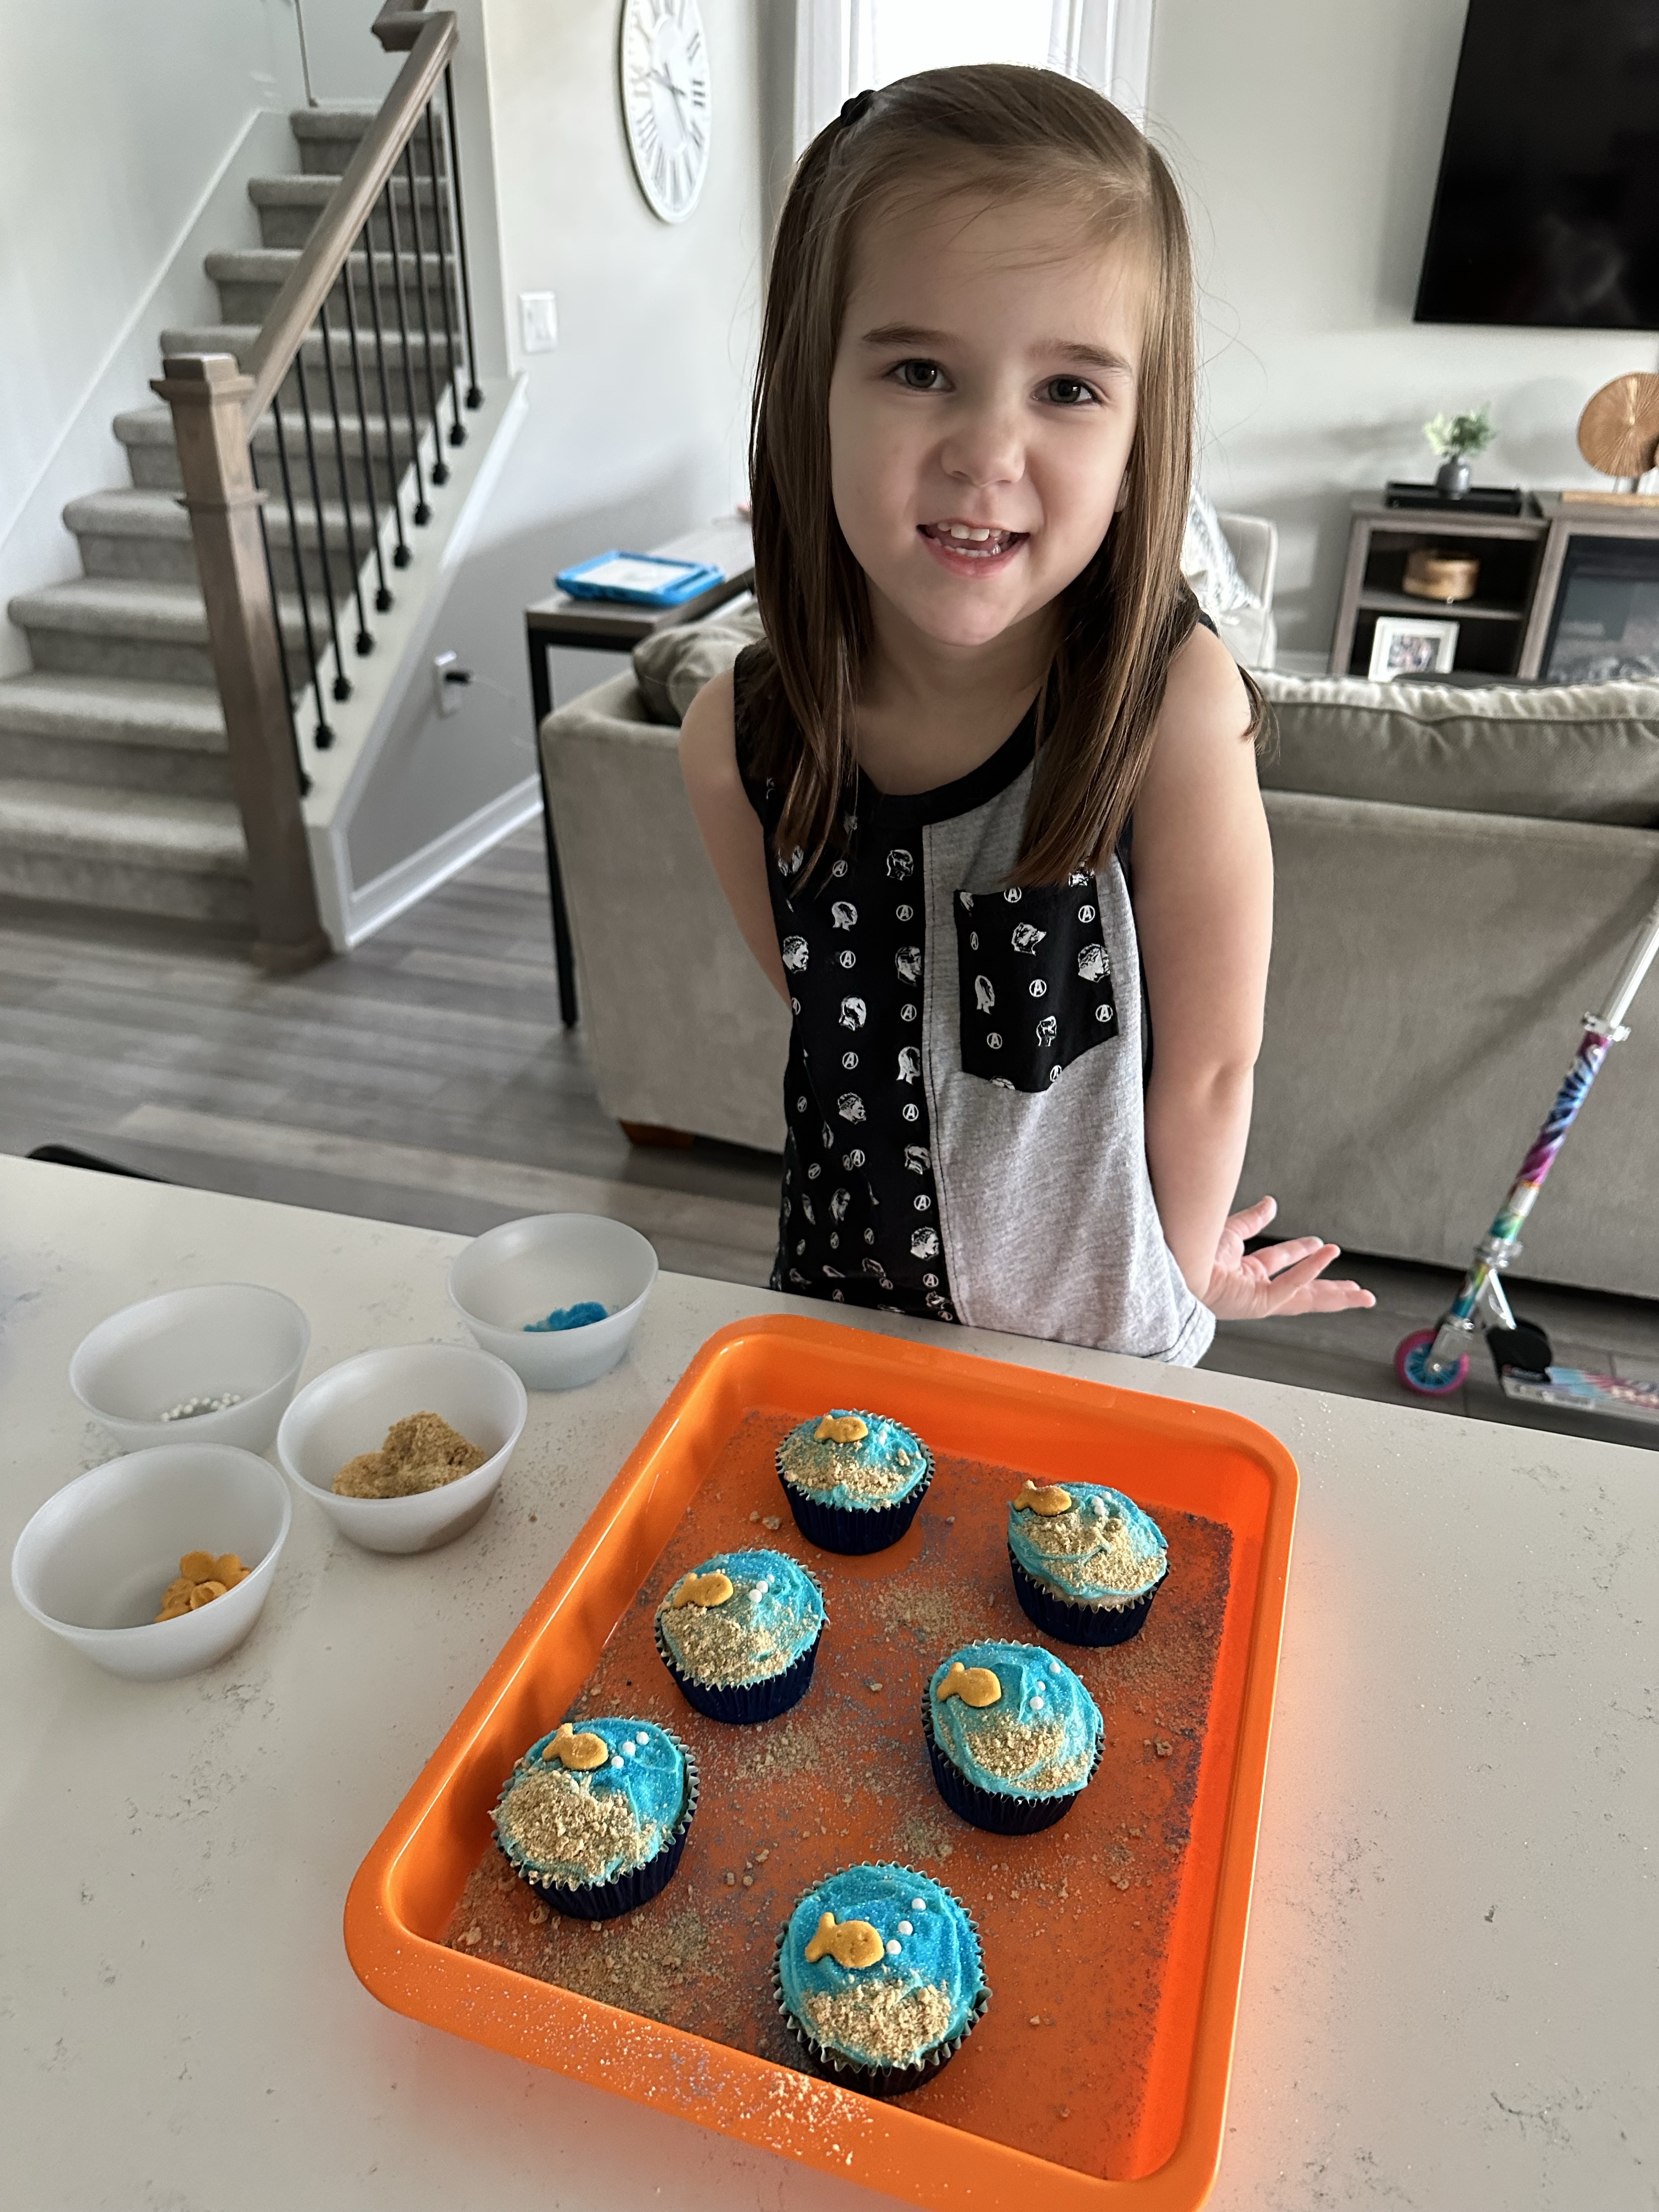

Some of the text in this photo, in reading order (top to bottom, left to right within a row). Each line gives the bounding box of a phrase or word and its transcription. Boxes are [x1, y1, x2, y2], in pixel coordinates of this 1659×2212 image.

[691, 78, 706, 108] III
[897, 905, 912, 921] A
[1079, 905, 1094, 923] A
[841, 950, 855, 968] A
[1030, 979, 1046, 997] A
[902, 1004, 916, 1022] A
[1097, 1005, 1111, 1022] A
[988, 1032, 1001, 1049] A
[843, 1052, 857, 1069] A
[904, 1104, 918, 1121] A
[915, 1194, 929, 1211] A
